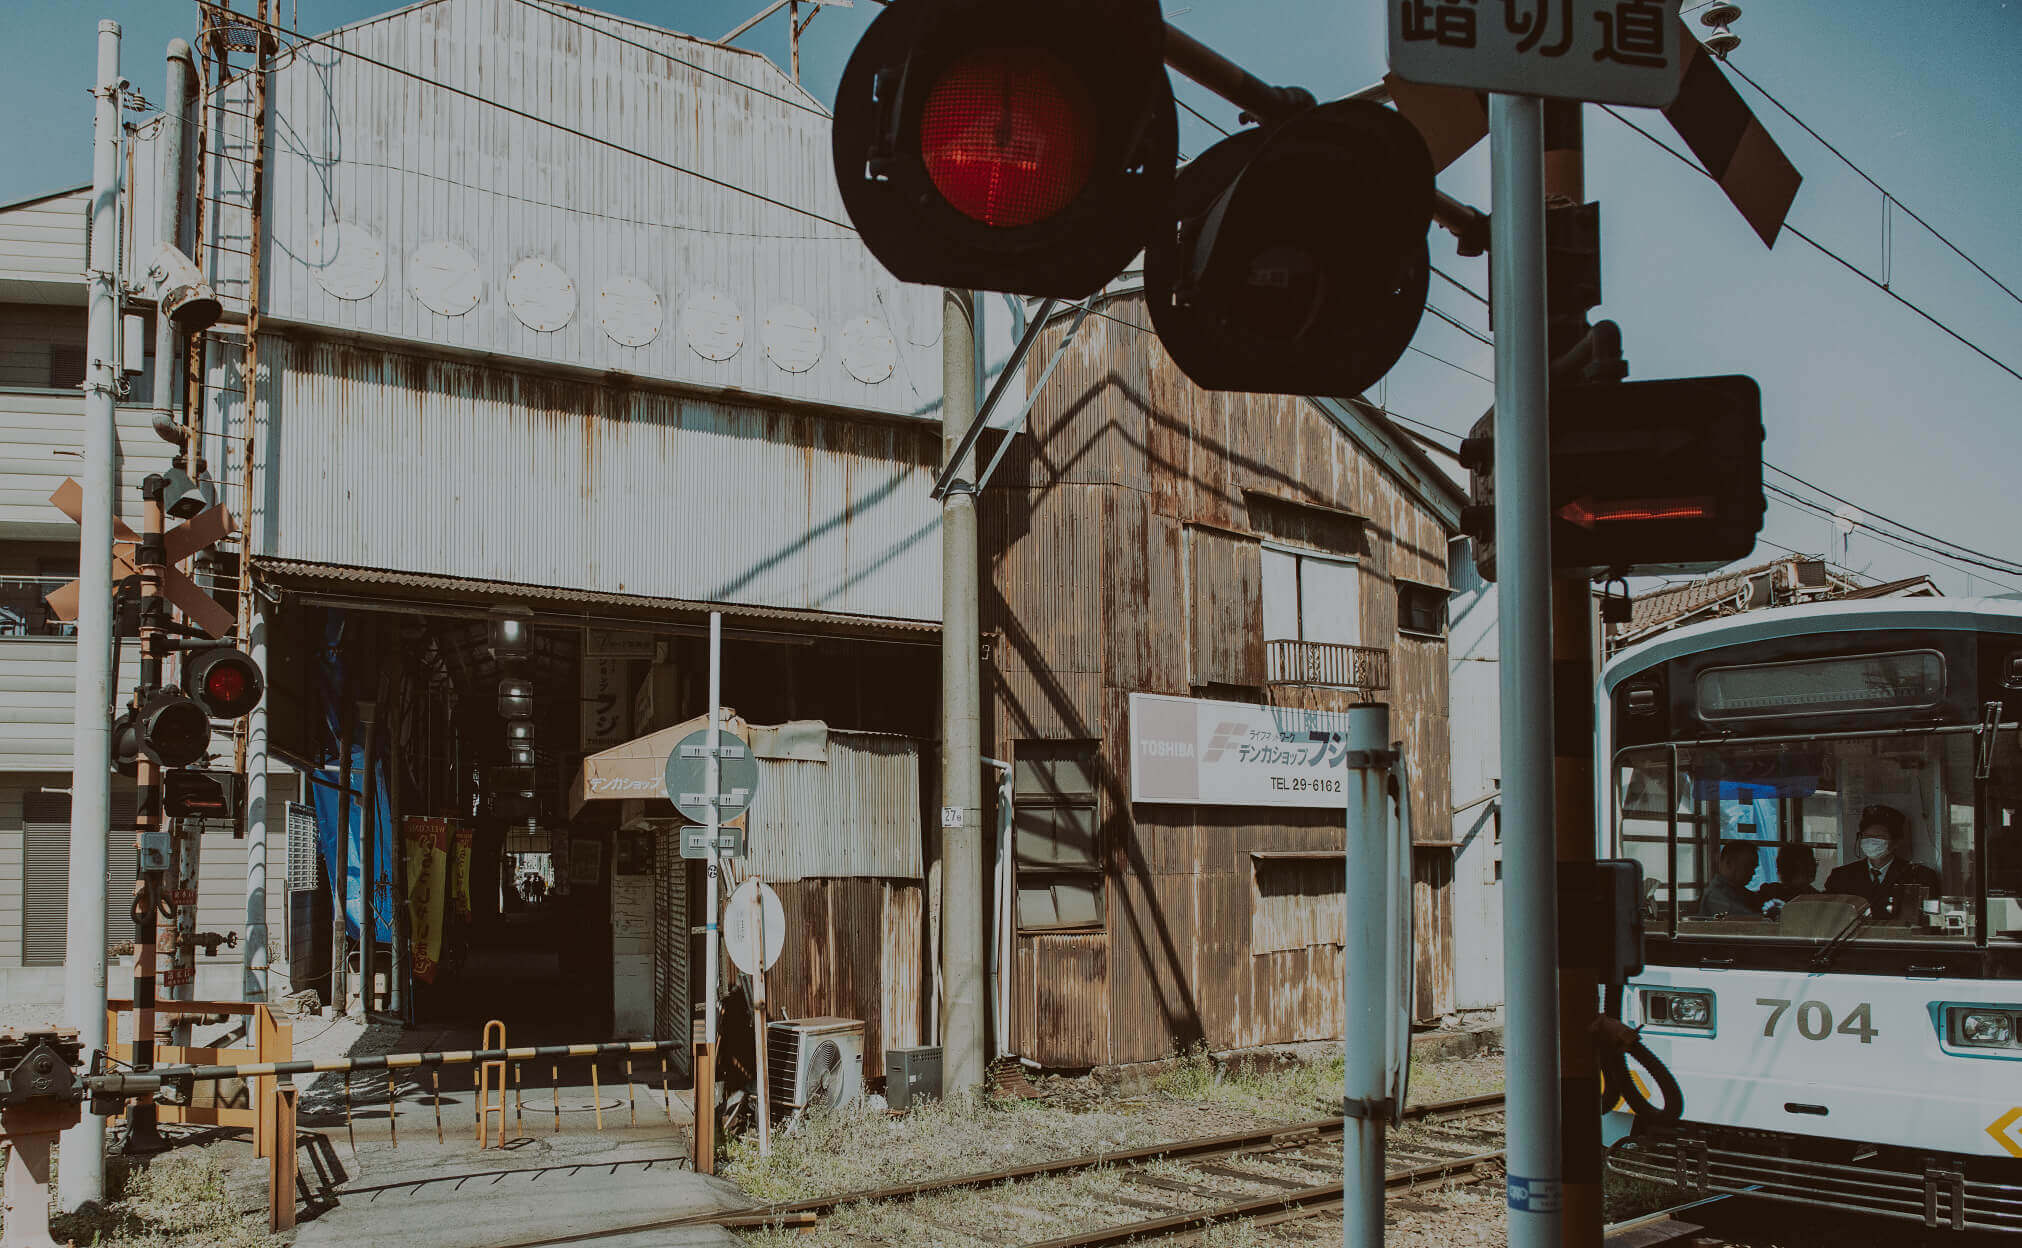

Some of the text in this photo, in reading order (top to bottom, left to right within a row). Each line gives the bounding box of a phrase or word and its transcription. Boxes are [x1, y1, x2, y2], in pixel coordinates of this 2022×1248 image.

[1140, 740, 1195, 759] TOSHIBA
[1270, 777, 1342, 793] TEL 29-6162
[1756, 997, 1879, 1044] 704
